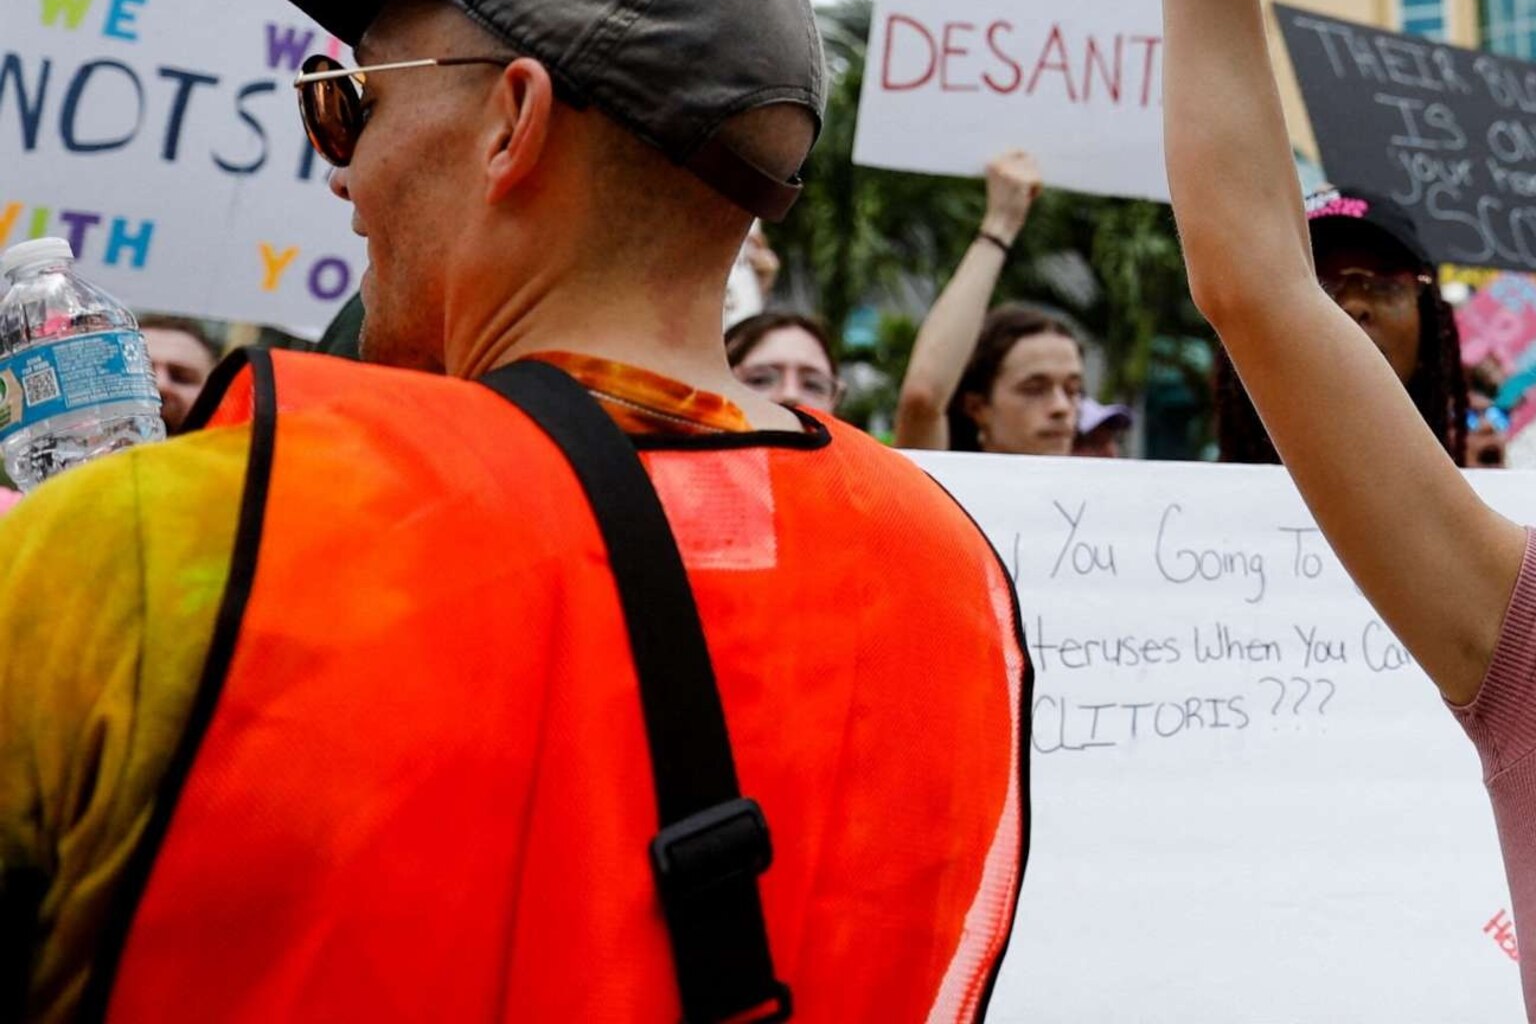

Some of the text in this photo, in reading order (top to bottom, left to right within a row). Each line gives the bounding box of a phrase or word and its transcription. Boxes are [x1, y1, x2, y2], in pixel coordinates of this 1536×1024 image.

[1293, 15, 1474, 95] THEIR
[1373, 91, 1469, 151] IS
[1049, 498, 1118, 580] You
[1155, 502, 1266, 605] Going
[1193, 621, 1282, 665] When
[1293, 623, 1347, 668] You
